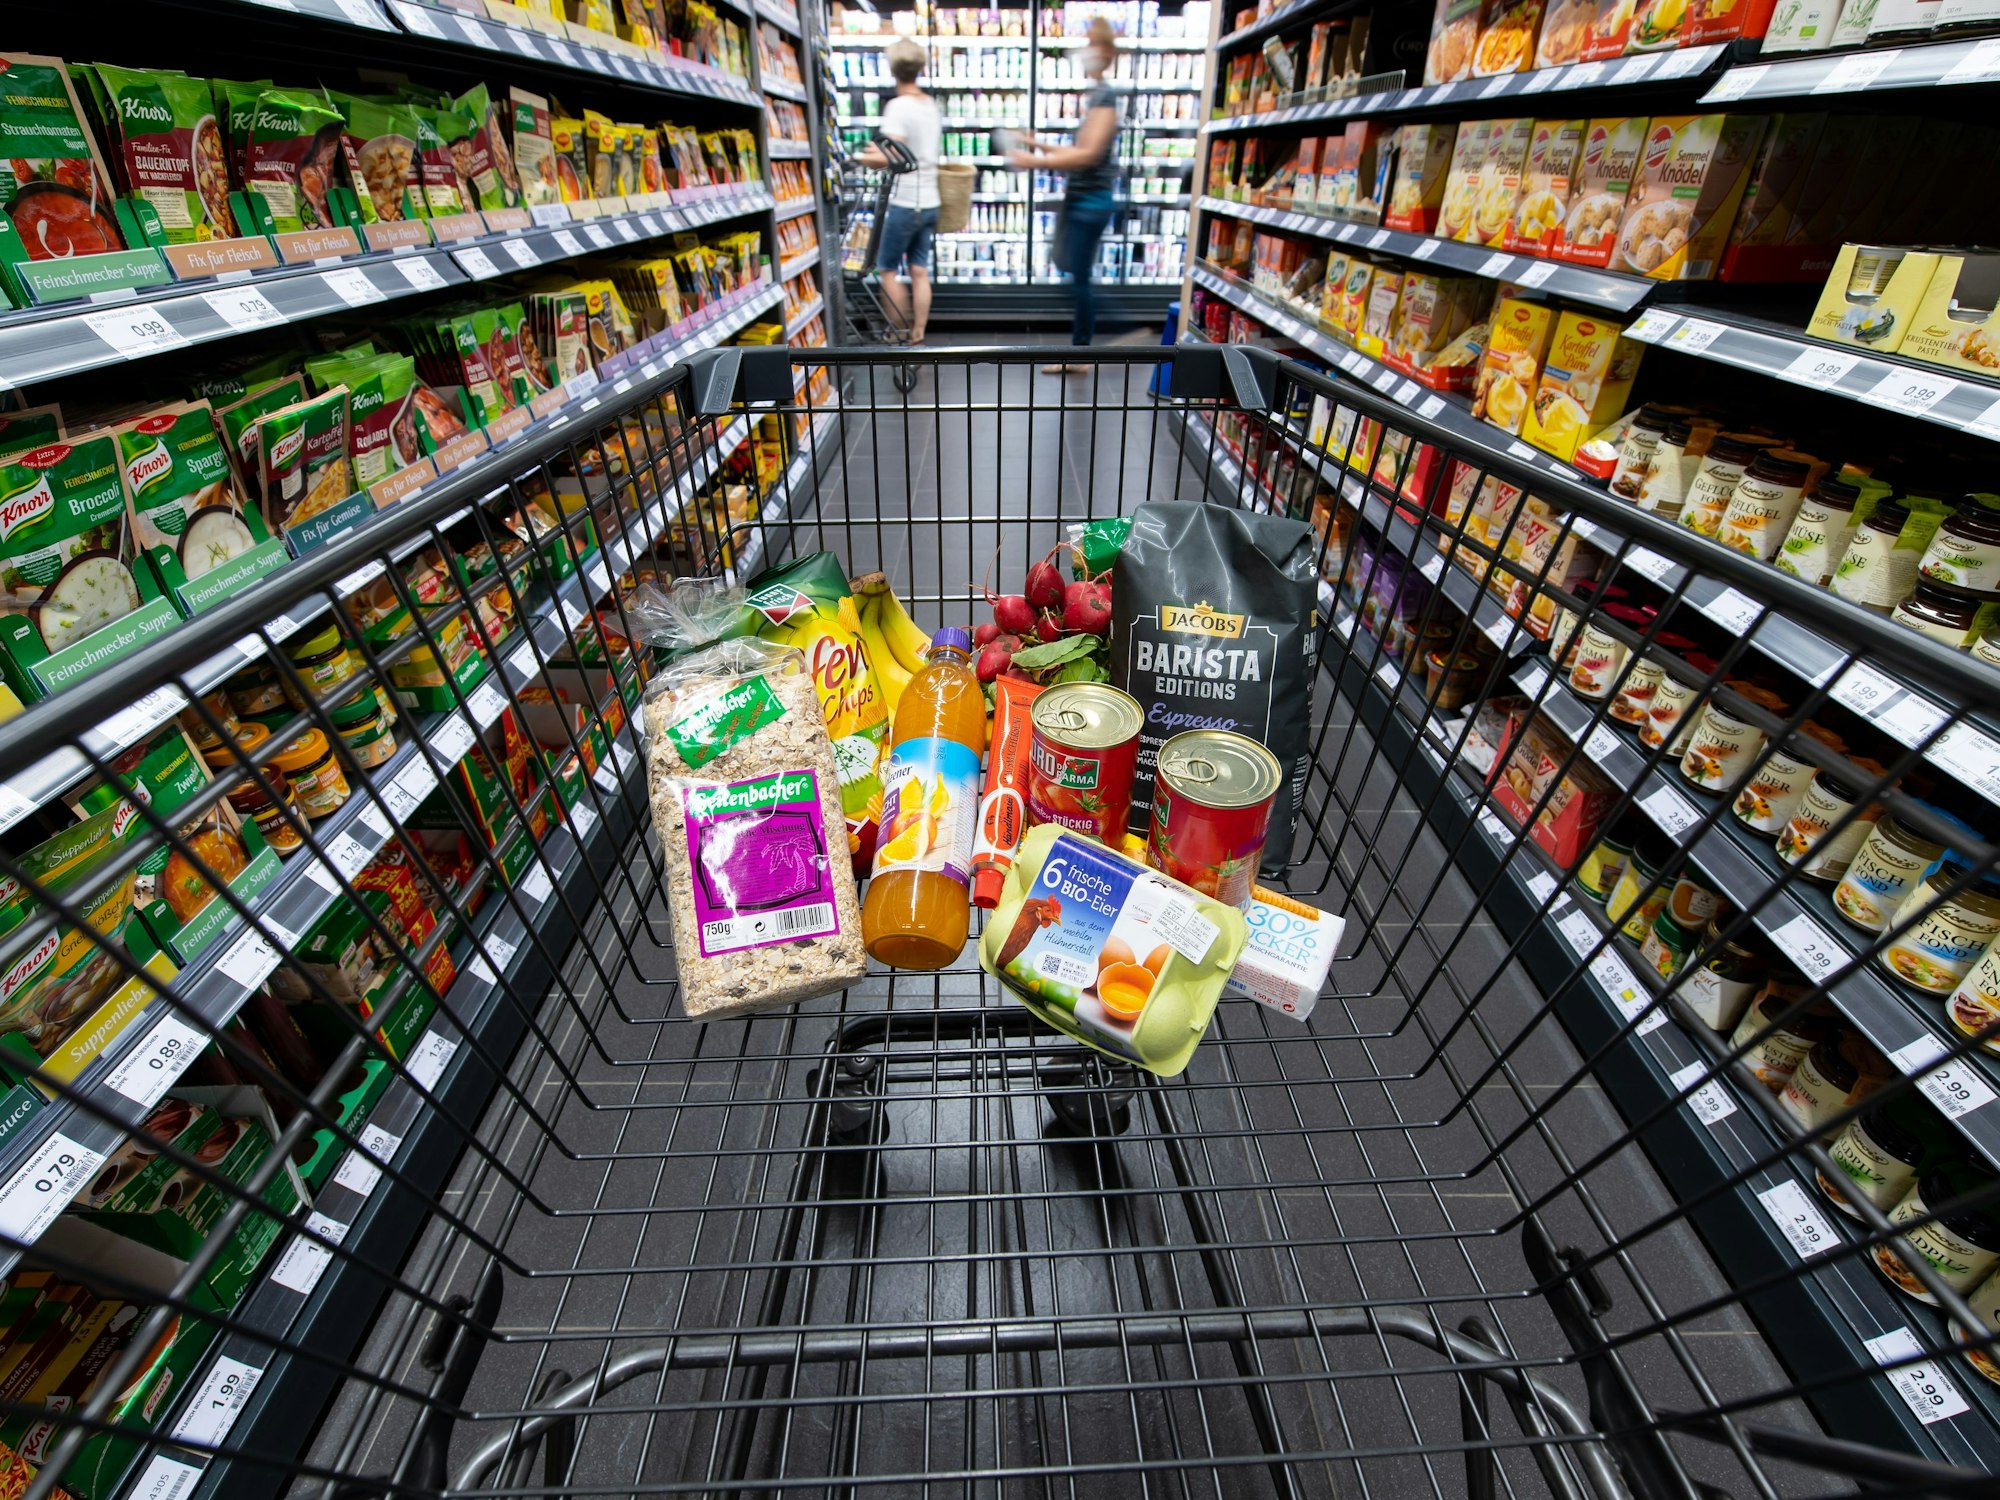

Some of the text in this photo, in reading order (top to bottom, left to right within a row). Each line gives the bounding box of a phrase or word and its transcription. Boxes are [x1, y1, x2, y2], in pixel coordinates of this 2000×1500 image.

[121, 97, 172, 122] Knorr
[1, 122, 82, 136] Strauchtomaten
[258, 111, 299, 132] Knorr
[135, 156, 190, 172] BAUERNTOPF
[1610, 148, 1636, 159] Semmel
[1677, 150, 1709, 162] Semmel
[140, 172, 150, 180] MIT
[1540, 158, 1571, 176] Knödel
[1596, 160, 1634, 179] Knödel
[1659, 164, 1705, 184] Knödel
[292, 234, 350, 256] Fix für Fleisch
[375, 227, 421, 244] Fix für Fleisch
[187, 244, 262, 271] Fix für Fleisch
[34, 262, 162, 290] Feinschmecker Suppe
[239, 300, 267, 314] 0.79
[131, 320, 165, 338] 0.99
[1690, 329, 1712, 344] 2.99
[1560, 334, 1601, 357] Kartoffel
[1906, 334, 1961, 351] KRUSTENTIER-
[1917, 346, 1940, 357] PASTE
[1565, 354, 1591, 372] Püree
[1814, 362, 1842, 376] 0.99
[351, 392, 384, 410] Knorr
[1904, 385, 1936, 402] 0.99
[274, 432, 303, 460] Knorr
[356, 428, 388, 448] ROULADEN
[36, 450, 55, 460] Extra
[128, 454, 169, 485] Knorr
[382, 468, 427, 499] Fix für Fleisch
[1738, 480, 1784, 500] Lacroix
[0, 491, 50, 528] Knorr
[68, 481, 120, 516] Broccoli
[302, 502, 362, 543] Fix für Gemüse
[1728, 510, 1758, 526] FOND
[1940, 536, 1977, 552] Lacroix
[1954, 554, 1984, 568] FOND
[190, 548, 284, 606] Feinschmecker Suppe
[763, 593, 795, 608] frisch
[1166, 612, 1237, 632] JACOBS
[48, 608, 174, 686] Feinschmecker Suppe
[1584, 631, 1617, 648] Lacroix
[459, 660, 480, 684] Bouillon
[1137, 640, 1261, 682] BARISTA
[1155, 676, 1237, 700] EDITIONS
[1850, 680, 1879, 700] 1.99
[824, 684, 874, 726] Chips
[1148, 702, 1239, 731] Espresso
[1704, 713, 1744, 736] Lacroix
[456, 722, 470, 738] 1.79
[1591, 736, 1608, 752] 2.99
[1974, 736, 1990, 748] LACROIX
[174, 762, 200, 794] Zwiebel
[1057, 771, 1095, 785] PARMA
[1136, 772, 1153, 782] FLAT
[390, 790, 408, 808] 1.79
[1510, 801, 1520, 812] 12
[760, 822, 806, 836] Mischung
[1052, 814, 1093, 829] STÜCKIG
[1669, 812, 1688, 830] 2.99
[340, 842, 362, 862] 1.79
[513, 844, 527, 866] Soße
[1868, 838, 1920, 870] Lacroix
[249, 859, 276, 886] Suppe
[1043, 858, 1112, 896] 6 frische
[1855, 864, 1888, 892] FOND
[1858, 849, 1906, 888] FISCH
[390, 880, 412, 901] 3er
[1060, 880, 1118, 918] BIO-Eier
[400, 891, 417, 913] Pack
[705, 922, 731, 936] 750g
[1062, 927, 1093, 942] mobilen
[1088, 922, 1105, 934] dem
[1246, 905, 1320, 949] 30%
[1918, 916, 1987, 952] FISCH
[492, 941, 506, 957] 1.29
[1044, 932, 1095, 956] Hühnerstall
[1919, 932, 1968, 958] FOND
[2, 936, 58, 996] Knorr
[1804, 944, 1832, 968] 2.99
[431, 954, 450, 984] Pack
[1606, 965, 1623, 984] 0.59
[1252, 990, 1266, 1000] 150
[70, 984, 150, 1064] Suppenliebe
[403, 1004, 424, 1035] Soße
[148, 1038, 182, 1070] 0.89
[1934, 1070, 1971, 1100] 2.99
[1698, 1088, 1720, 1112] 2.99
[1850, 1122, 1890, 1166] Lacroix
[27, 1139, 59, 1173] RAHM SAUCE
[34, 1154, 76, 1193] 0.79
[1794, 1214, 1822, 1244] 2.99
[86, 1336, 120, 1378] mit Rind
[144, 1372, 172, 1417] Knorr
[212, 1374, 241, 1410] 1.99
[1910, 1370, 1944, 1408] 2.99
[180, 1410, 196, 1432] FLEISCH
[194, 1384, 213, 1413] BOUILLON
